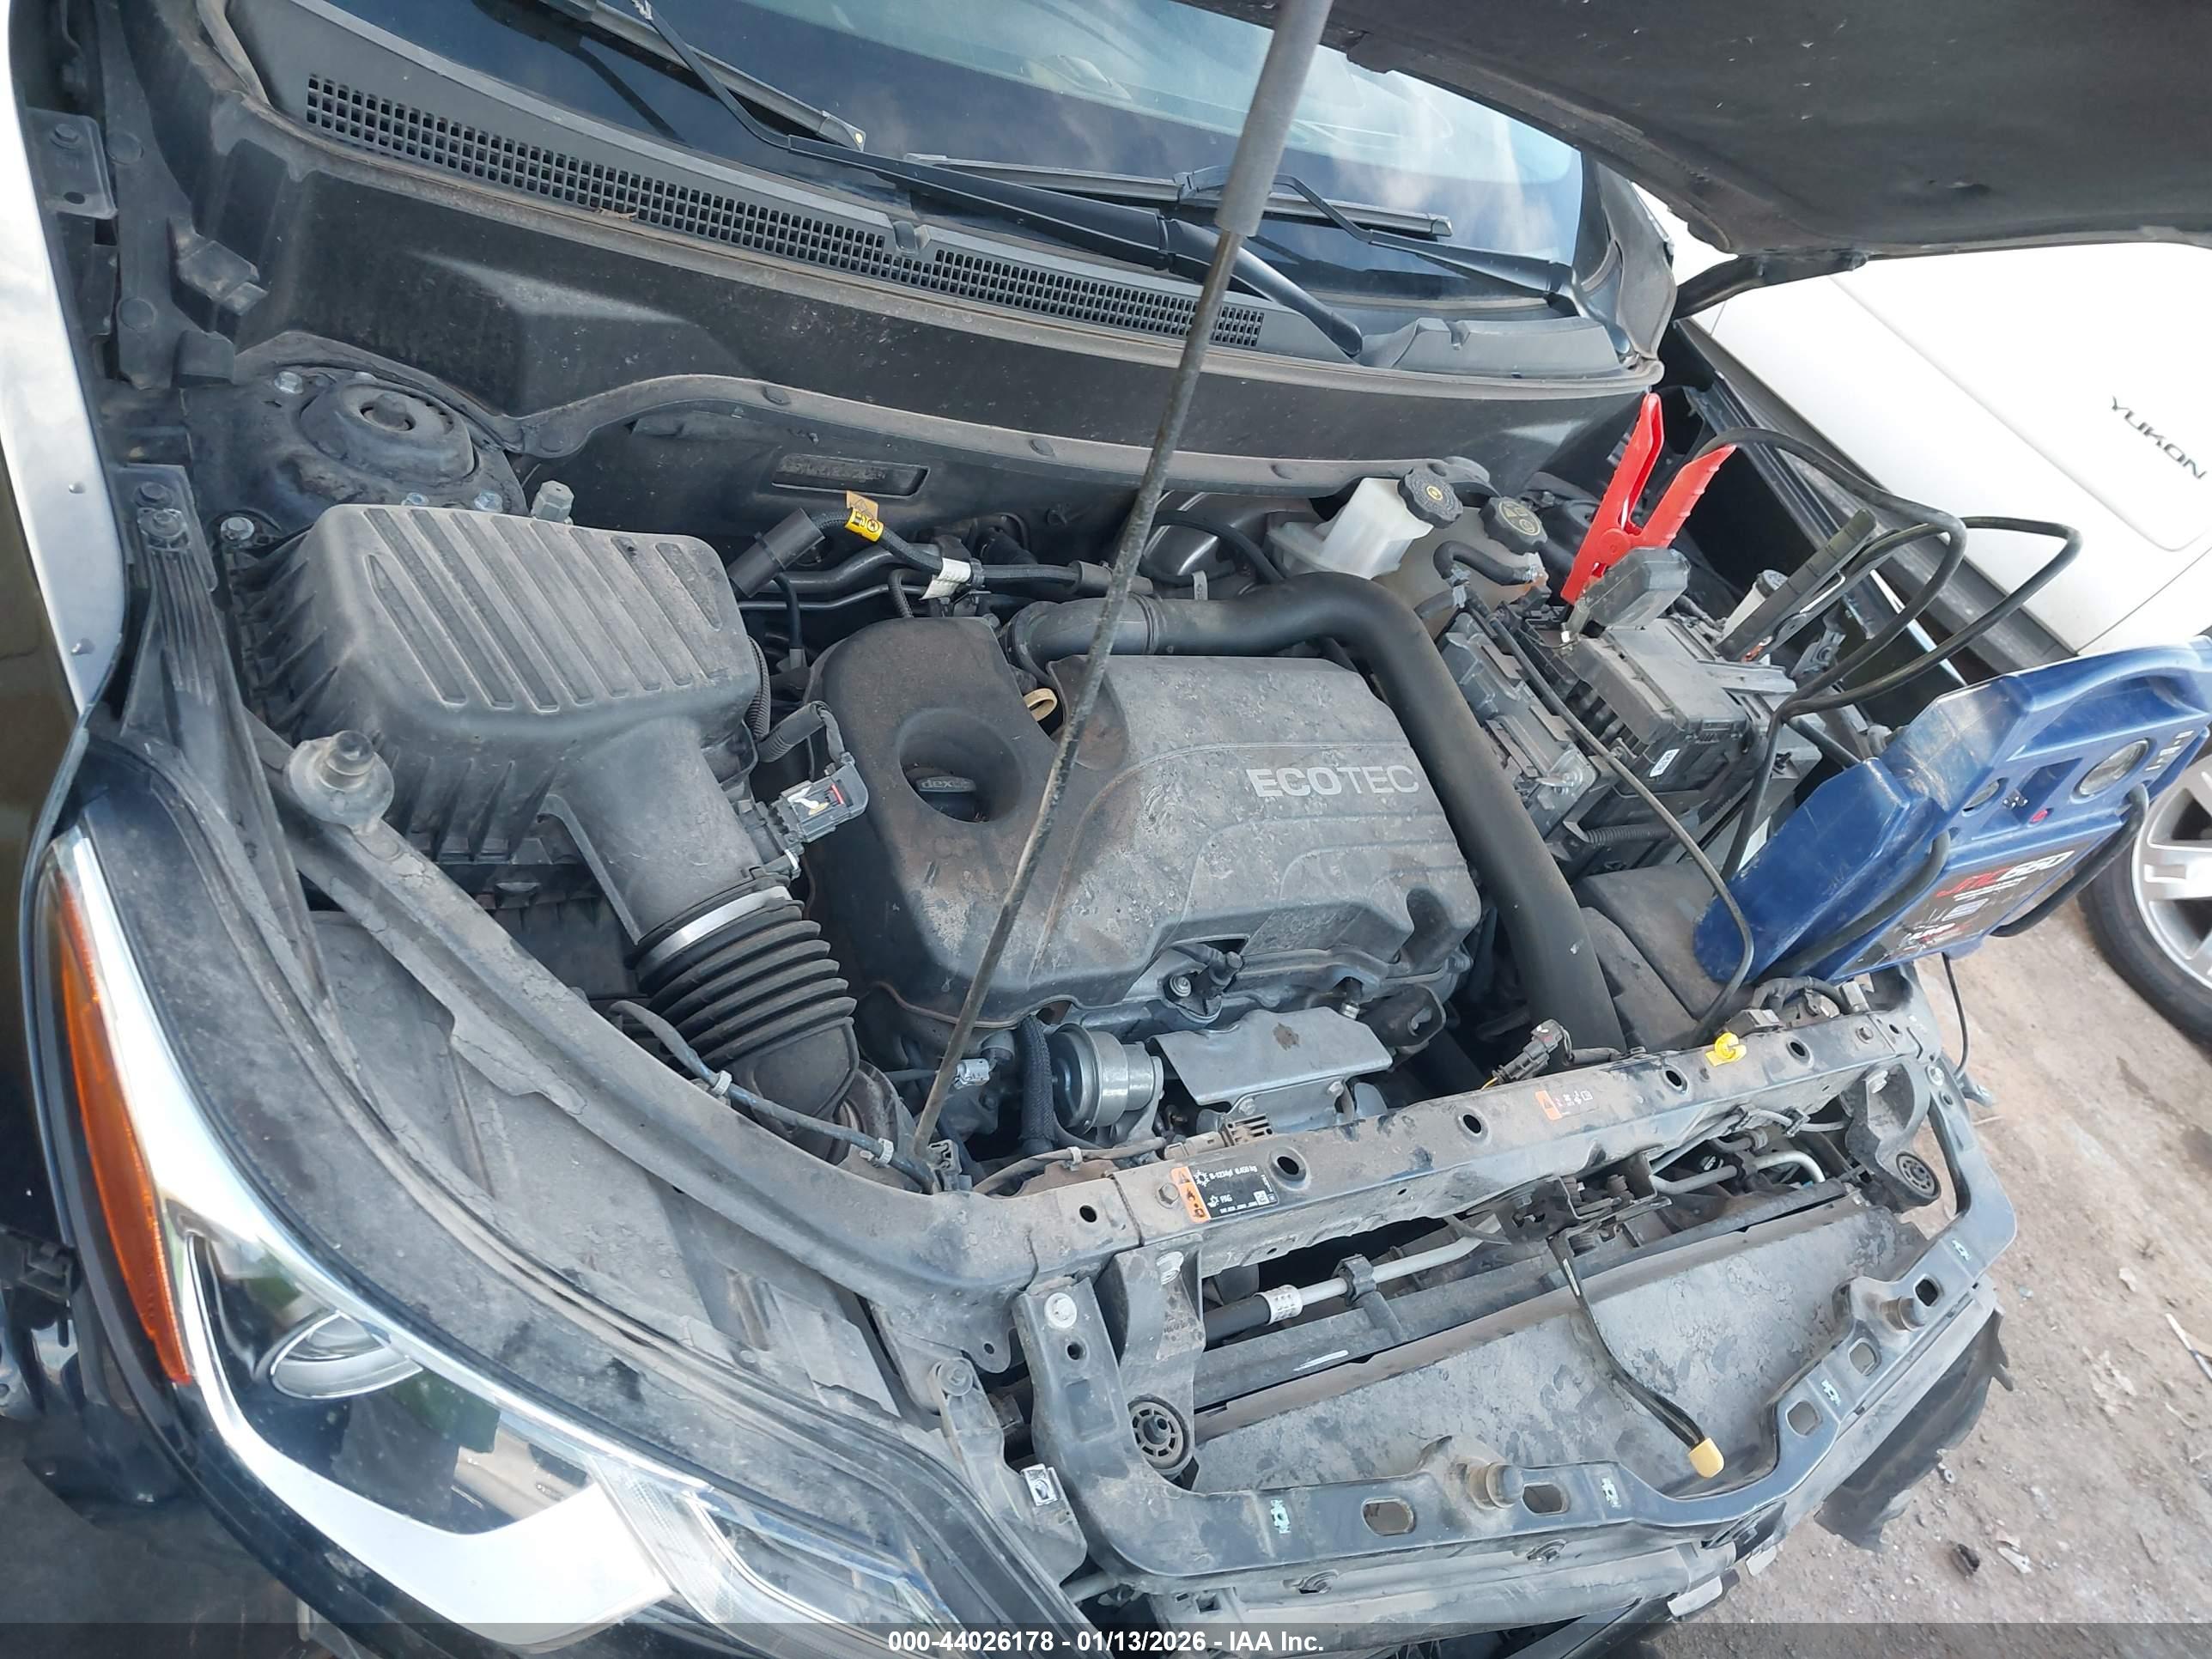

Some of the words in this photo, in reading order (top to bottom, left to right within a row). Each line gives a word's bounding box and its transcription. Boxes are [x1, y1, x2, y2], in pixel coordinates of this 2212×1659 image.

[2112, 394, 2207, 479] YUKON
[1246, 764, 1419, 797] ECOTEC
[1219, 1194, 1233, 1204] PAG
